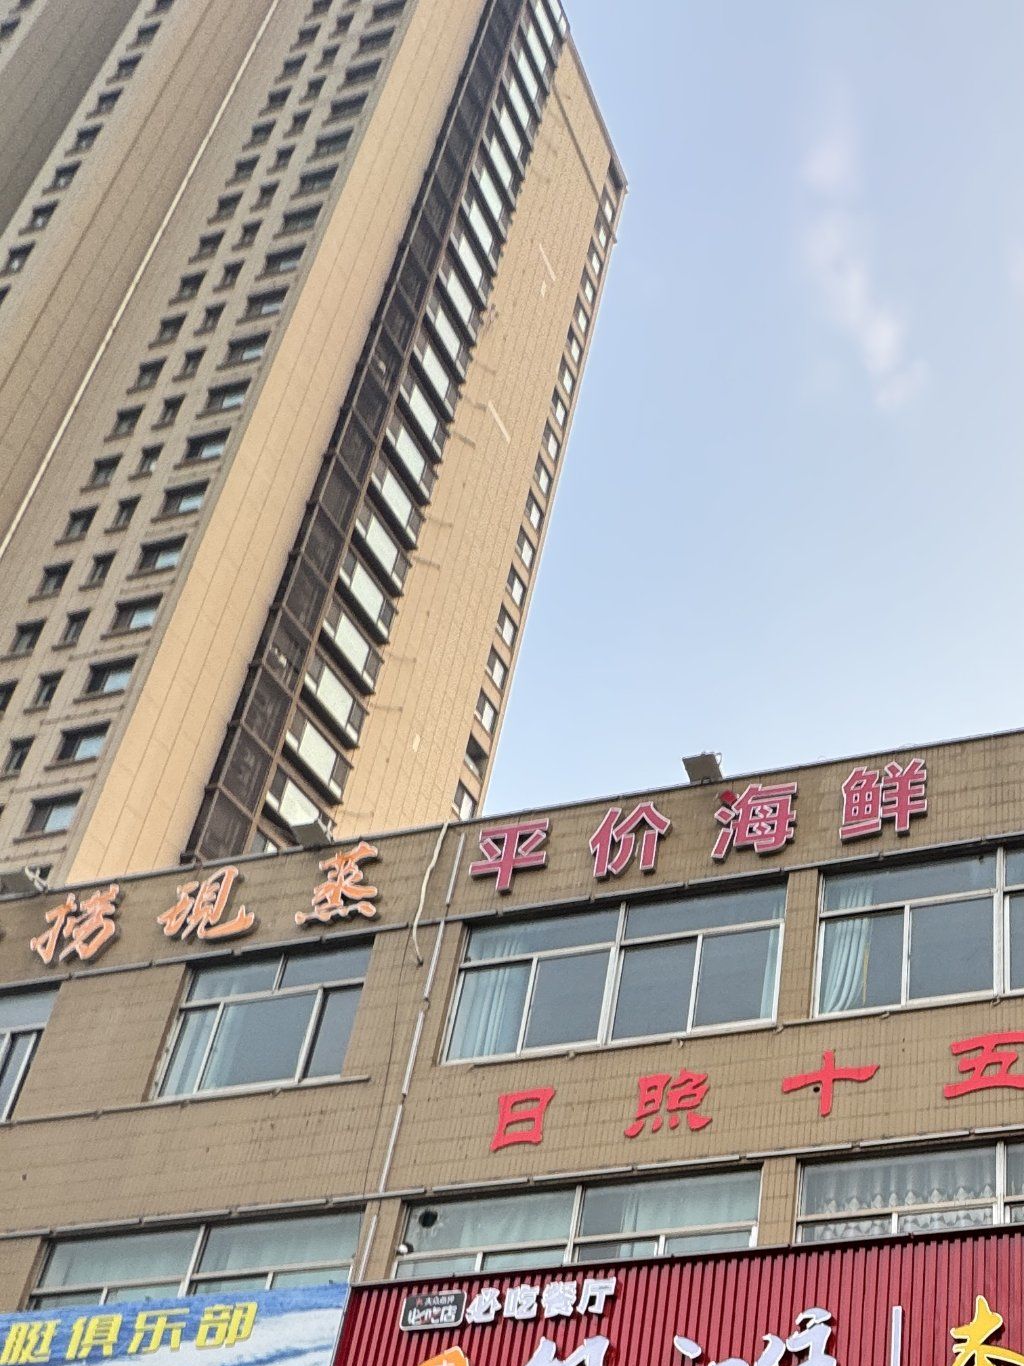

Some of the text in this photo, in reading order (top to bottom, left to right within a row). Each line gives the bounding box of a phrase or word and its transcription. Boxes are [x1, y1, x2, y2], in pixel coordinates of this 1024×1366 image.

[469, 758, 928, 893] 平价海鲜
[465, 1276, 616, 1325] 必吃餐厅
